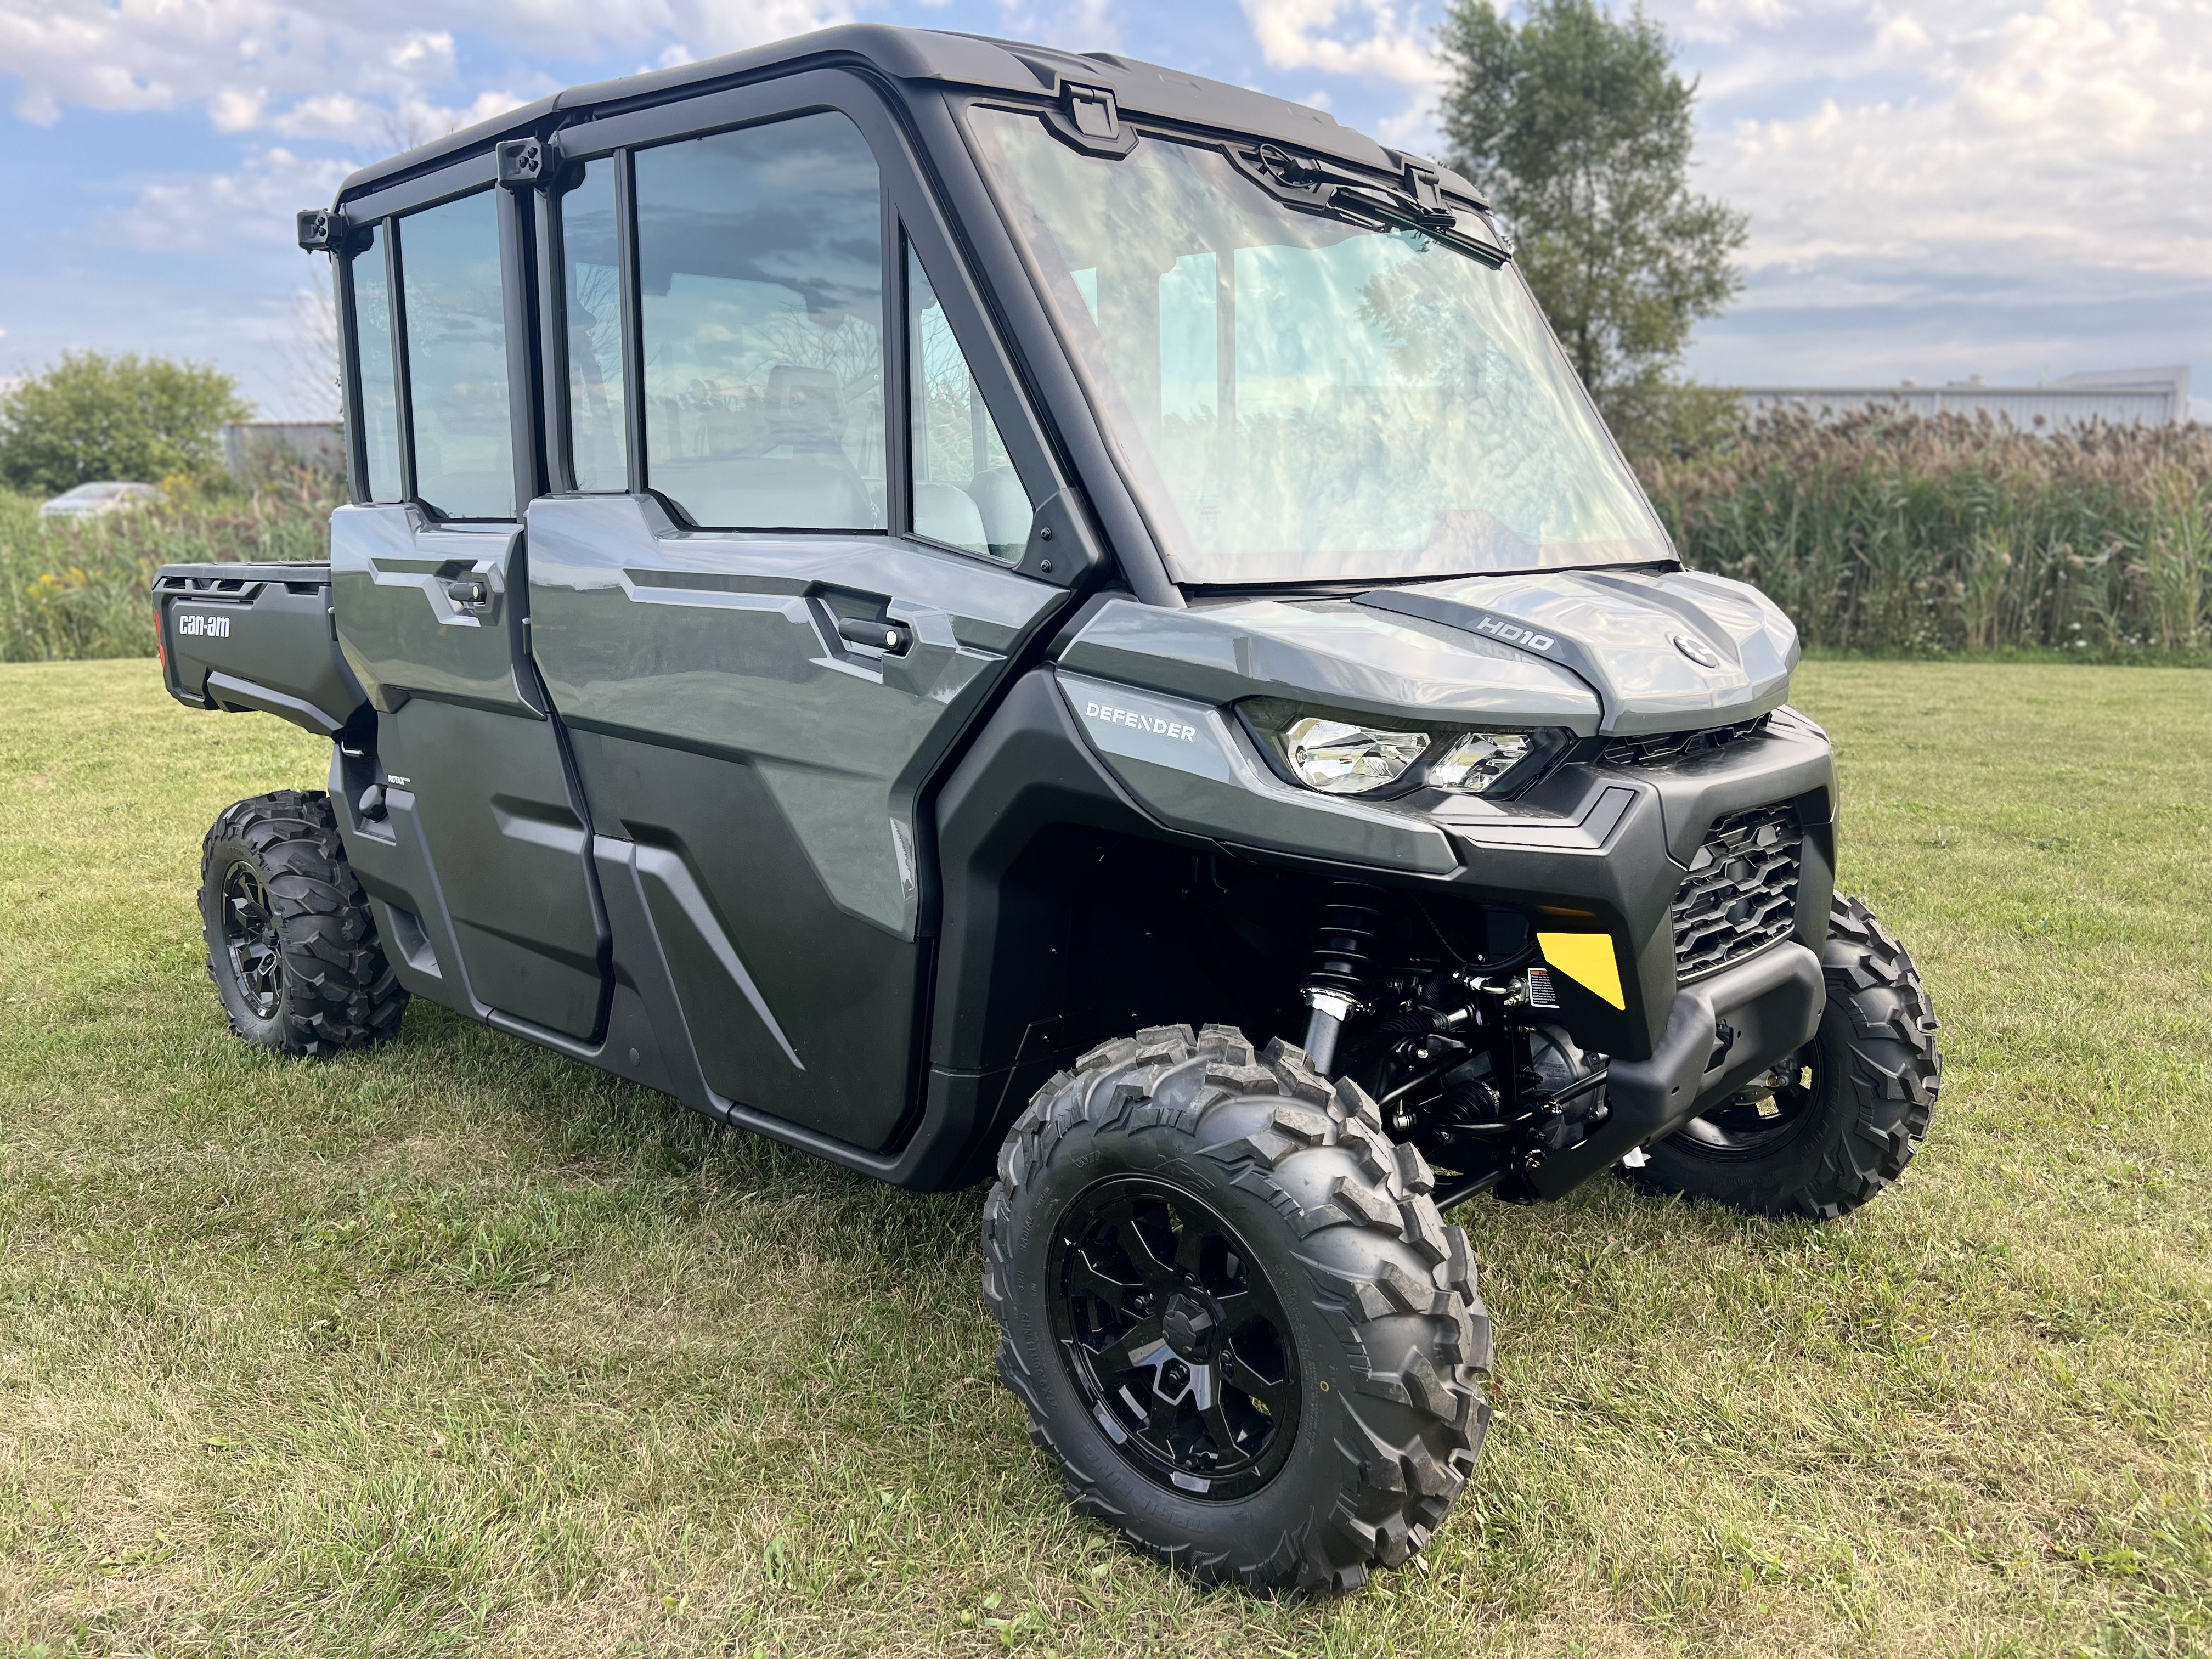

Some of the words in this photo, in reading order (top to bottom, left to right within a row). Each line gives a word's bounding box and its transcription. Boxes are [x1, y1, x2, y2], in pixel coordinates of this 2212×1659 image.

[179, 615, 230, 637] can-am
[1476, 617, 1554, 651] HD10
[1086, 707, 1195, 742] DEFENDER
[388, 774, 405, 785] ROTAX
